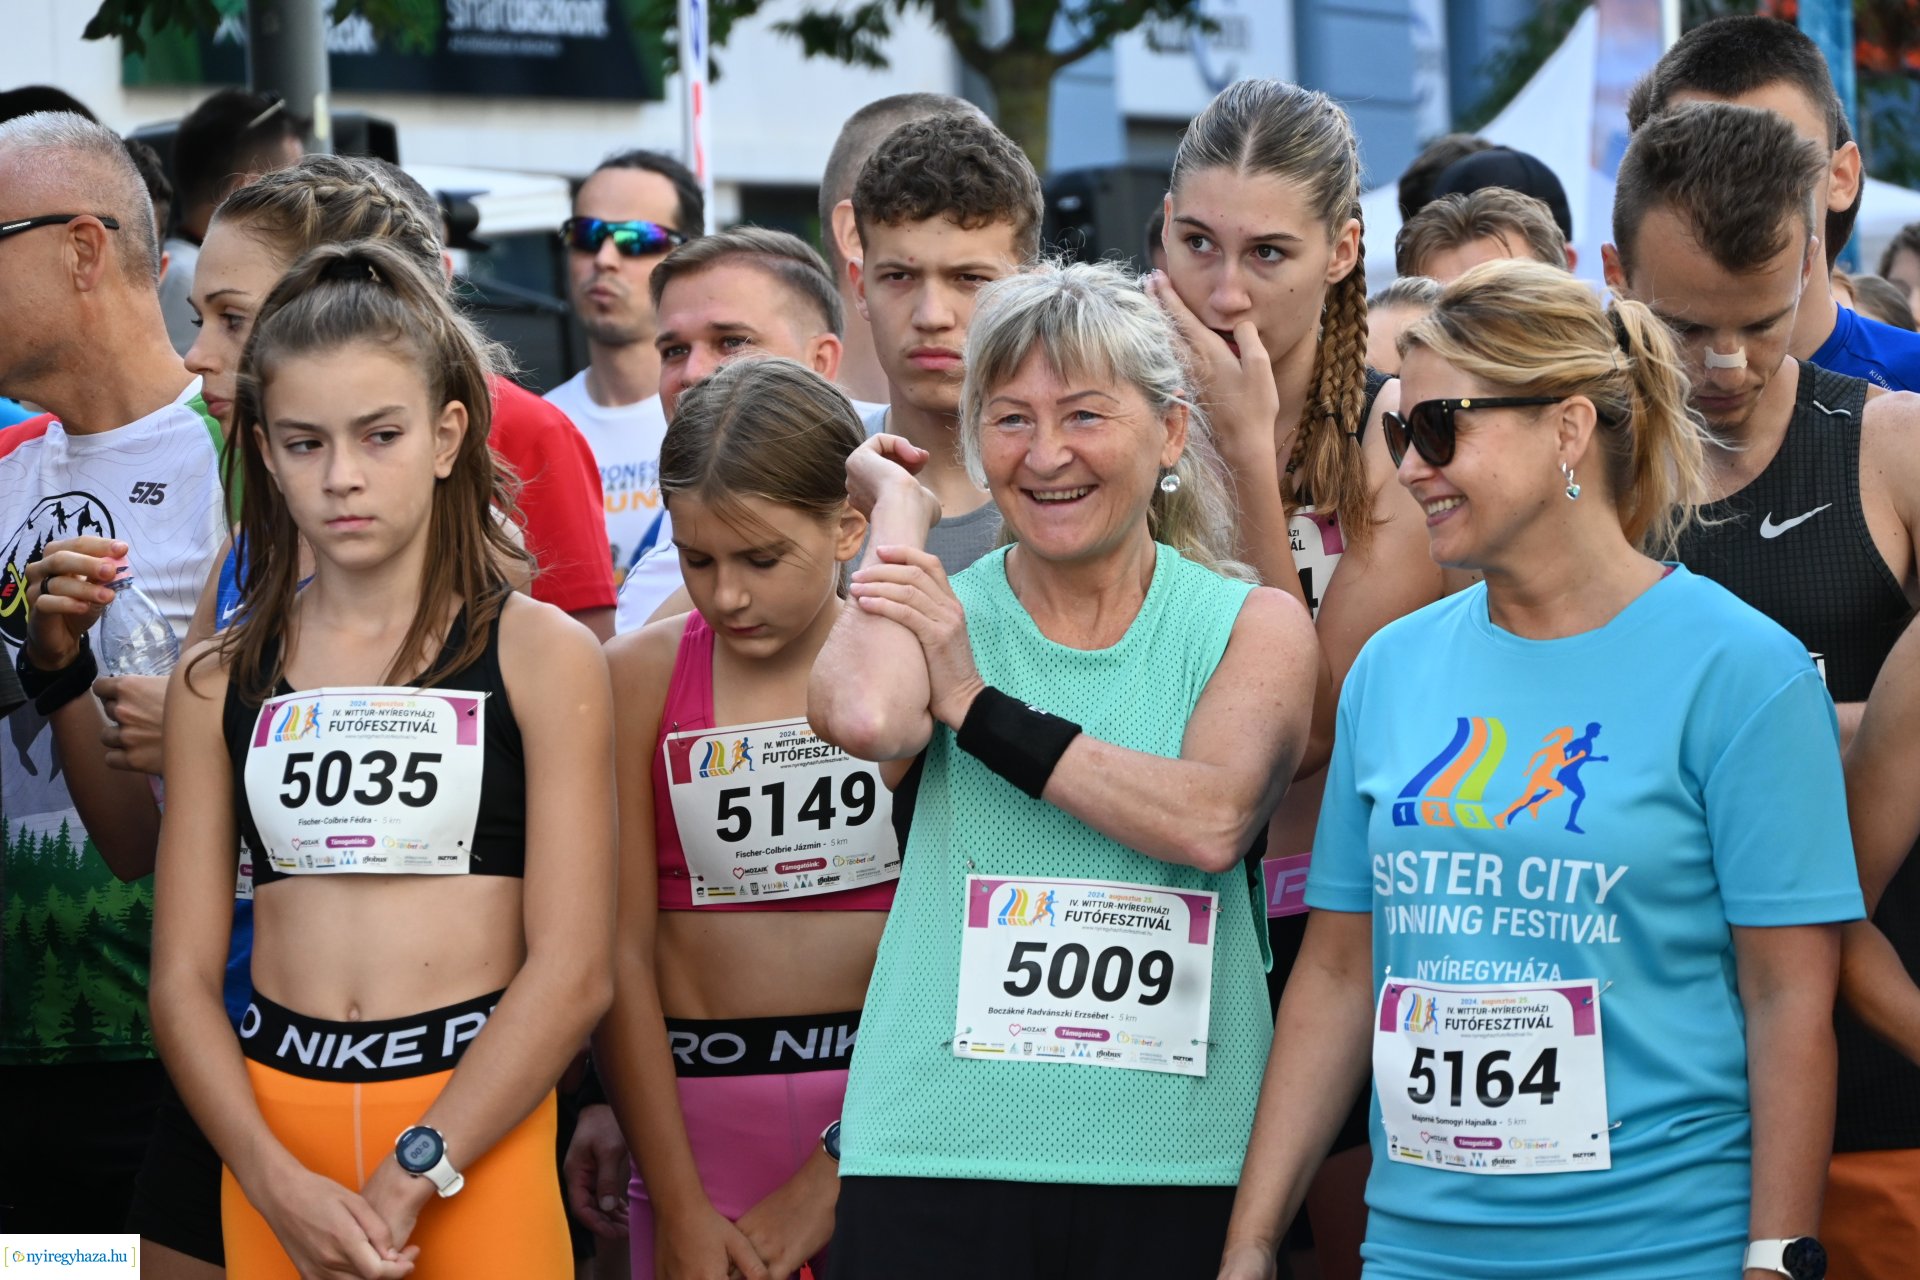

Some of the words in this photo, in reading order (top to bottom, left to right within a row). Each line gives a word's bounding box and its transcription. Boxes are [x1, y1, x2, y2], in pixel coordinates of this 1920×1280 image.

[605, 488, 657, 513] UN
[344, 707, 435, 718] WITTUR-NYÍREGYHÁZI
[328, 717, 438, 734] FUTÓFESZTIVÁL
[762, 745, 847, 764] FUTÓFESZTI
[764, 741, 773, 750] IV.
[279, 750, 443, 809] 5035
[717, 771, 876, 843] 5149
[1399, 805, 1407, 822] 1
[1429, 804, 1444, 822] 2
[1466, 806, 1479, 824] 3
[298, 816, 348, 826] Fischer-Colbrie
[349, 816, 372, 825] Fédra
[735, 845, 792, 859] Fischer-Colbrie
[793, 841, 821, 852] Jázmin
[830, 839, 835, 847] 5
[836, 837, 848, 847] km
[745, 866, 768, 874] MOZAIK
[781, 860, 820, 872] Támogatóink:
[817, 875, 841, 886] globus
[1373, 850, 1503, 897] SISTER
[1517, 856, 1629, 905] CITY
[1069, 899, 1079, 907] IV.
[1082, 900, 1170, 915] WITTUR-NYÍREGYHÁZI
[1108, 893, 1142, 902] augusztus
[1064, 909, 1172, 931] FUTÓFESZTIVÁL
[1384, 903, 1483, 936] UNNING
[1492, 906, 1622, 944] FESTIVAL
[1003, 941, 1174, 1006] 5009
[1417, 954, 1562, 983] NYÍREGYHÁZA
[988, 1006, 1025, 1016] Boczákné
[1026, 1007, 1072, 1018] Radvánszki
[1074, 1010, 1109, 1020] Erzsébet
[1119, 1013, 1124, 1022] 5
[1125, 1014, 1138, 1023] km
[1457, 1004, 1549, 1015] WITTUR-NYÍREGYHÁZI
[1444, 1014, 1554, 1031] FUTÓFESZTIVÁL
[276, 1024, 427, 1069] NIKE
[668, 1030, 747, 1065] RO
[769, 1025, 859, 1062] NIK
[1096, 1050, 1122, 1058] globus
[1407, 1047, 1560, 1108] 5164
[1435, 1116, 1464, 1128] Somogyi
[1465, 1118, 1497, 1128] Hajnalka
[1507, 1118, 1512, 1126] 5
[1513, 1118, 1527, 1126] km
